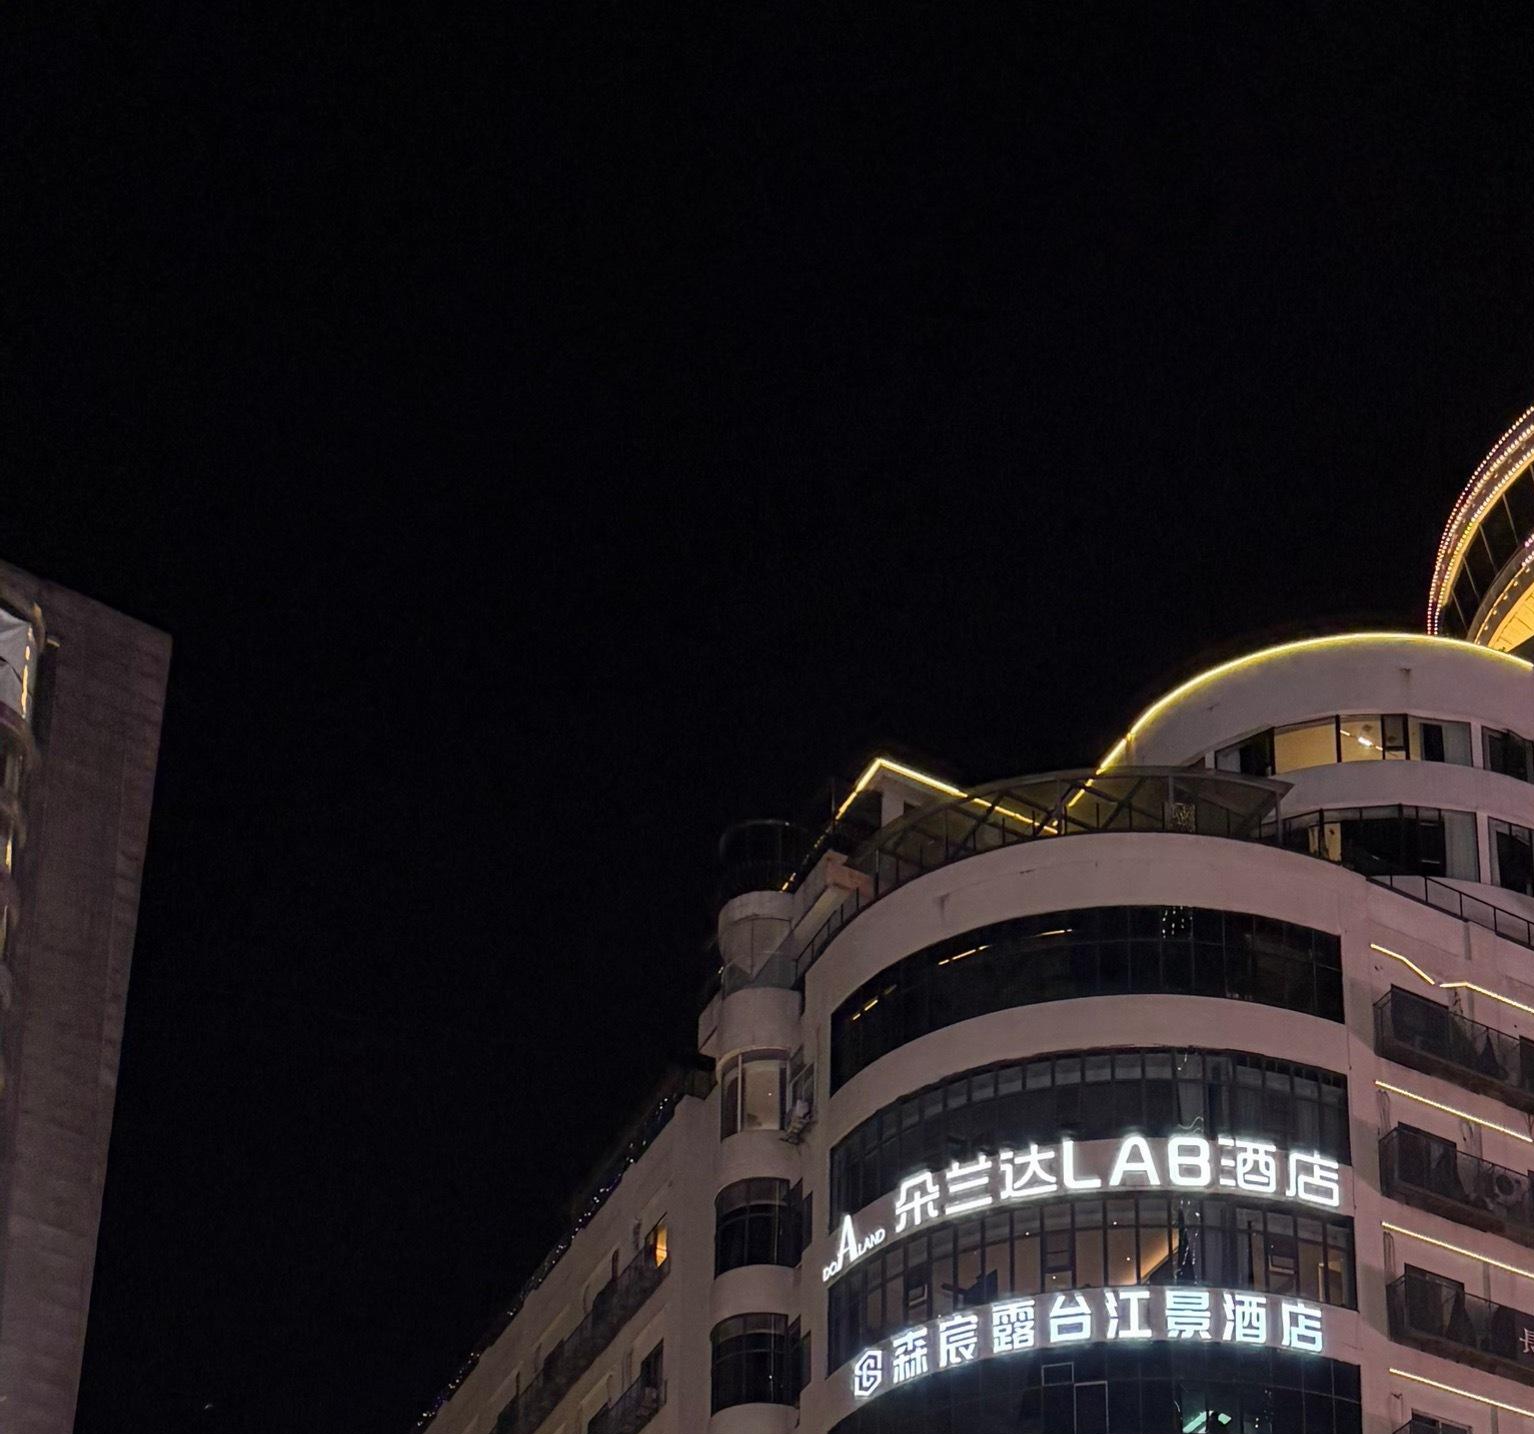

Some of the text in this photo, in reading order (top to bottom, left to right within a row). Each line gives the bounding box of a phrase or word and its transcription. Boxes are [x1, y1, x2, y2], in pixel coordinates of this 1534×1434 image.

[895, 1134, 1341, 1233] 朵兰达LAB酒店
[893, 1288, 1324, 1384] 森宸露台江景酒店
